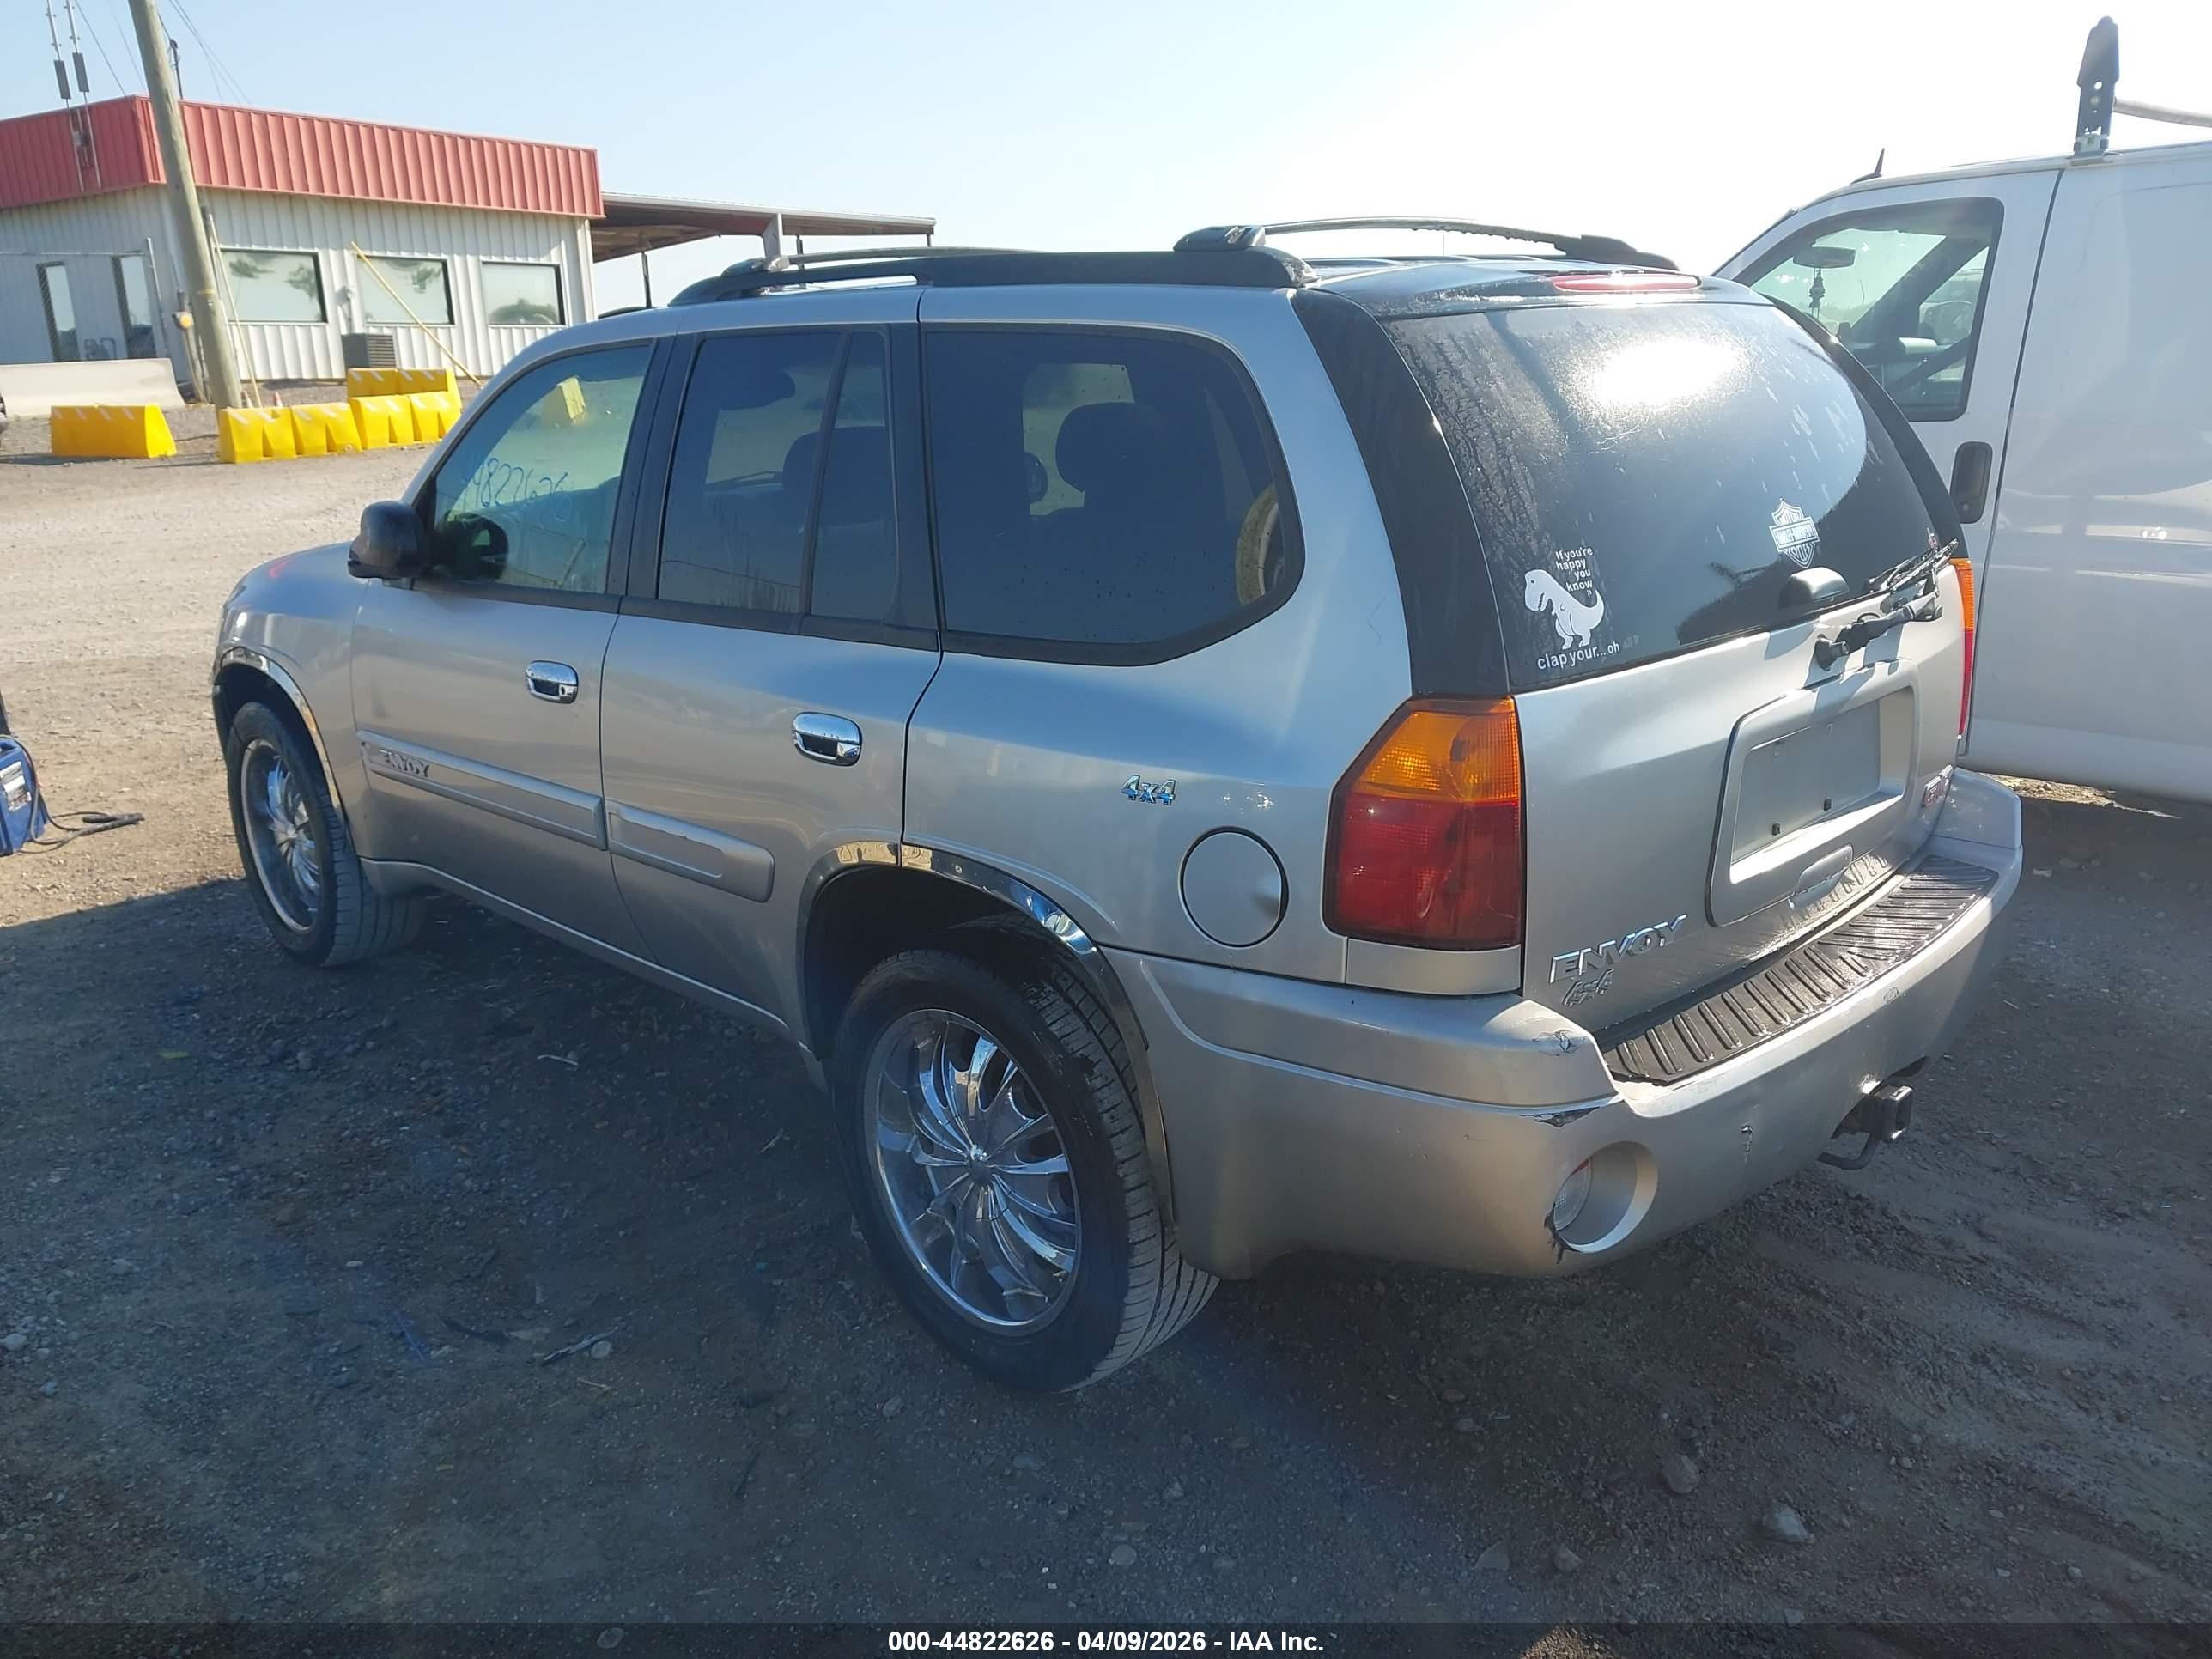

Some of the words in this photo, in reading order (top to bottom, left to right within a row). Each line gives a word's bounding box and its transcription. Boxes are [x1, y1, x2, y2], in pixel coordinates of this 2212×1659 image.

[1555, 550, 1564, 562] If
[1564, 547, 1594, 562] you're
[1555, 558, 1586, 572] happy
[1574, 568, 1591, 581] you
[1566, 580, 1593, 592] know
[1537, 653, 1568, 670] clap
[1569, 646, 1607, 668] your...
[1607, 641, 1620, 654] oh
[379, 749, 430, 778] ENVOY
[1548, 913, 1688, 984] ENVOY
